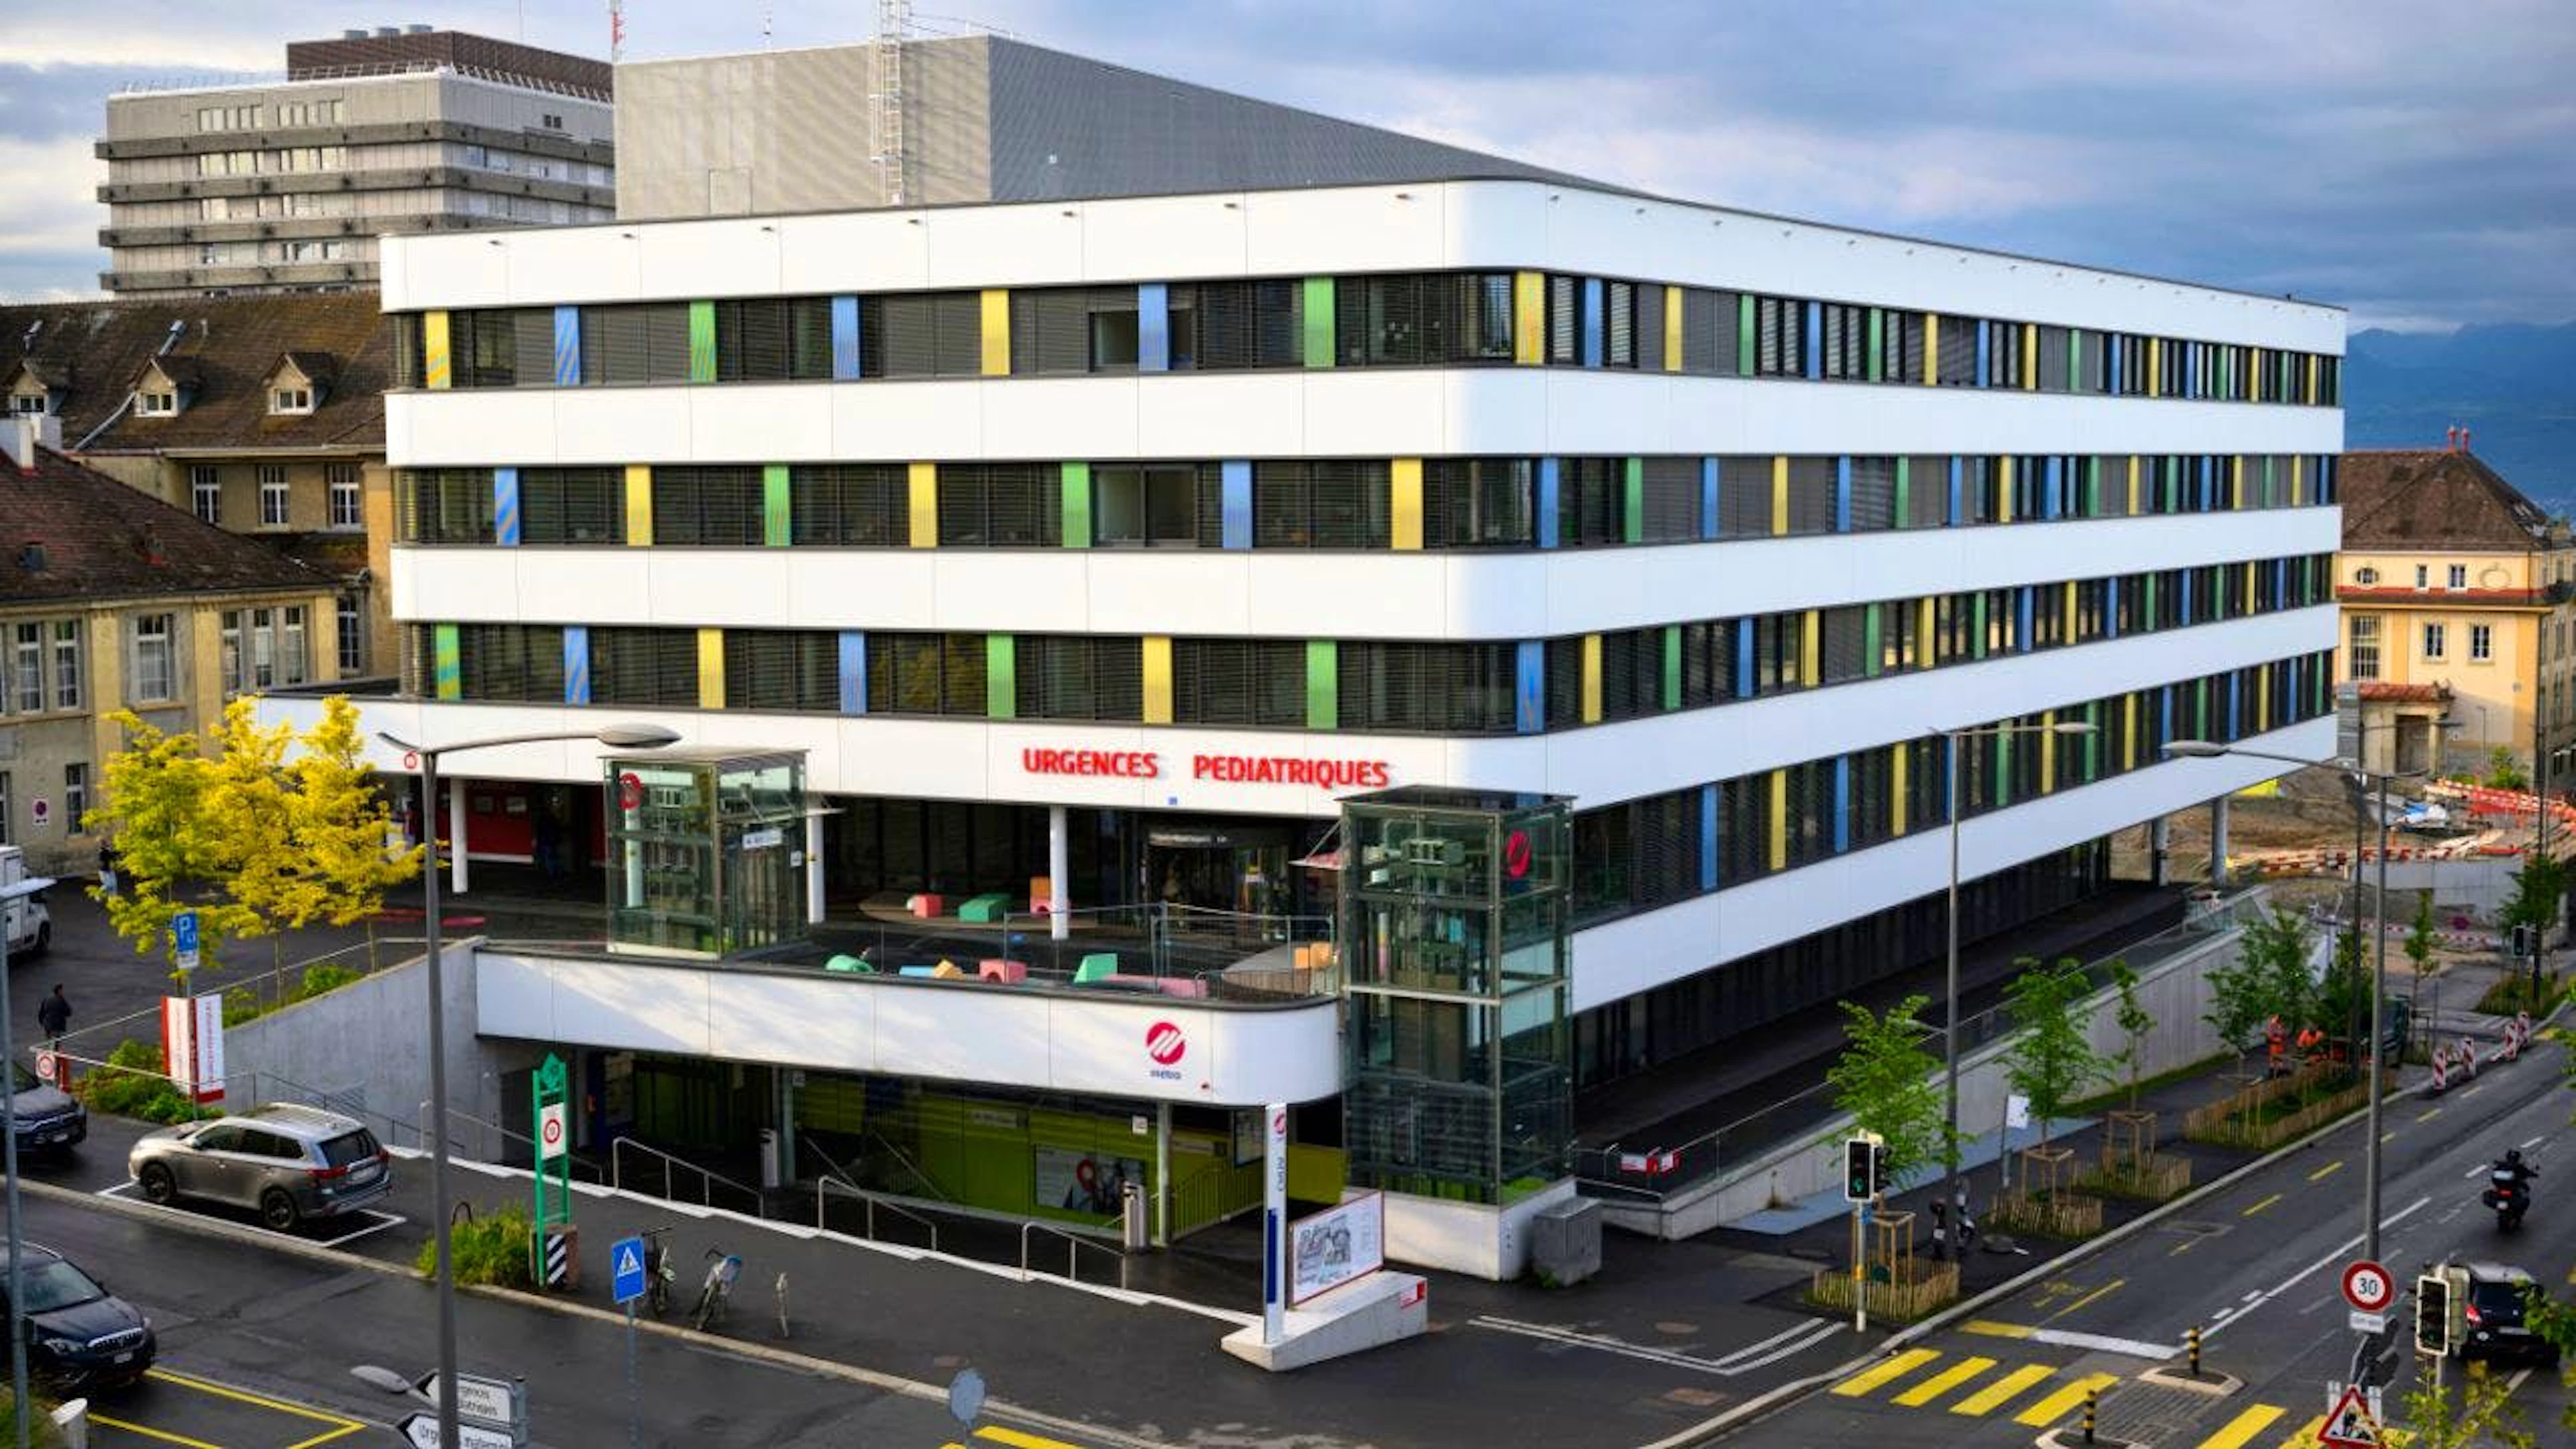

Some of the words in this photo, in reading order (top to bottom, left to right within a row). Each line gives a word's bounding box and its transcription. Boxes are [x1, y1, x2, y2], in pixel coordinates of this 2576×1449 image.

[1023, 749, 1158, 778] URGENCES
[1193, 755, 1388, 789] PEDIATRIQUES
[2359, 1277, 2377, 1296] 30
